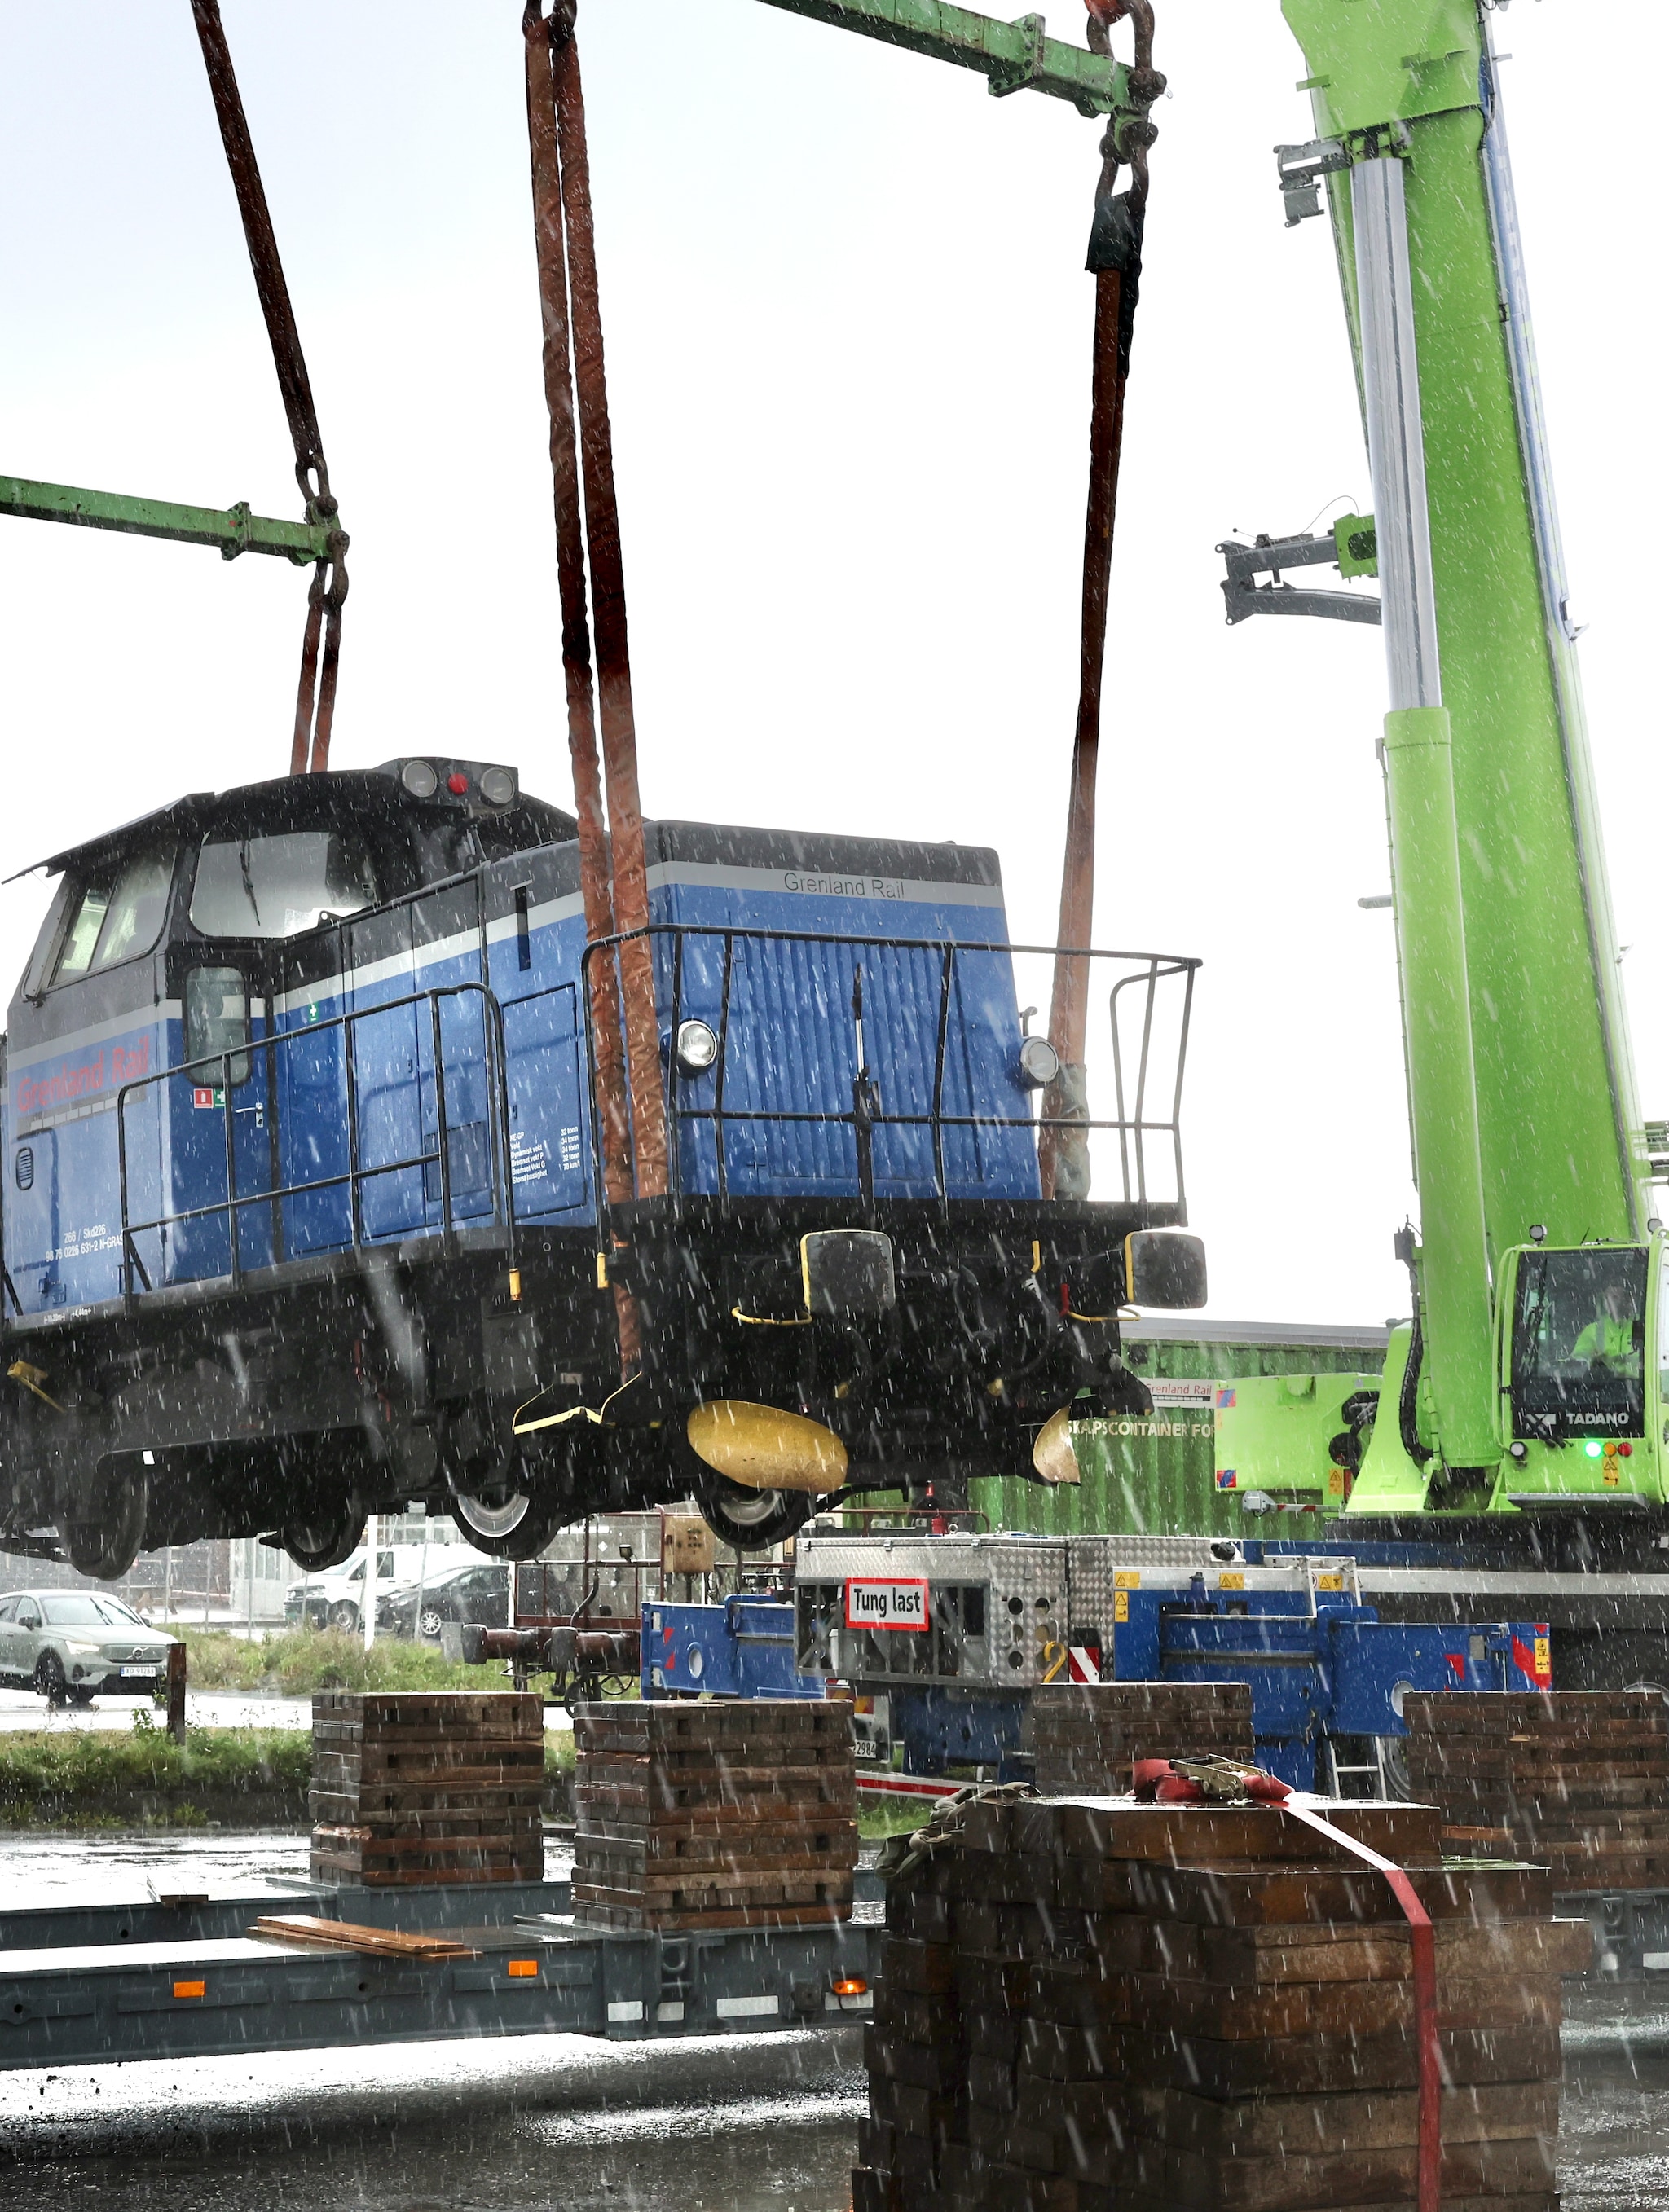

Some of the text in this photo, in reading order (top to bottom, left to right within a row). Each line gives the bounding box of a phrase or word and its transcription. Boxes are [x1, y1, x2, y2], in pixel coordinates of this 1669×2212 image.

[784, 872, 905, 899] Grenland Rail
[17, 1035, 149, 1113] Grenland Rail
[561, 1128, 567, 1136] 32
[567, 1126, 579, 1134] tonn
[561, 1137, 567, 1145] 34
[568, 1135, 579, 1143] tonn
[561, 1145, 568, 1154] 34
[540, 1160, 546, 1168] G
[562, 1154, 569, 1162] 32
[569, 1152, 580, 1160] tonn
[563, 1163, 570, 1171] 70
[83, 1224, 106, 1239] Skd226
[45, 1250, 54, 1262] 98
[55, 1248, 63, 1260] 76
[64, 1244, 80, 1258] 0226
[81, 1240, 98, 1255] 631-2
[1194, 1385, 1212, 1395] Rail
[1566, 1413, 1629, 1425] TADANO
[853, 1587, 920, 1618] Tung last
